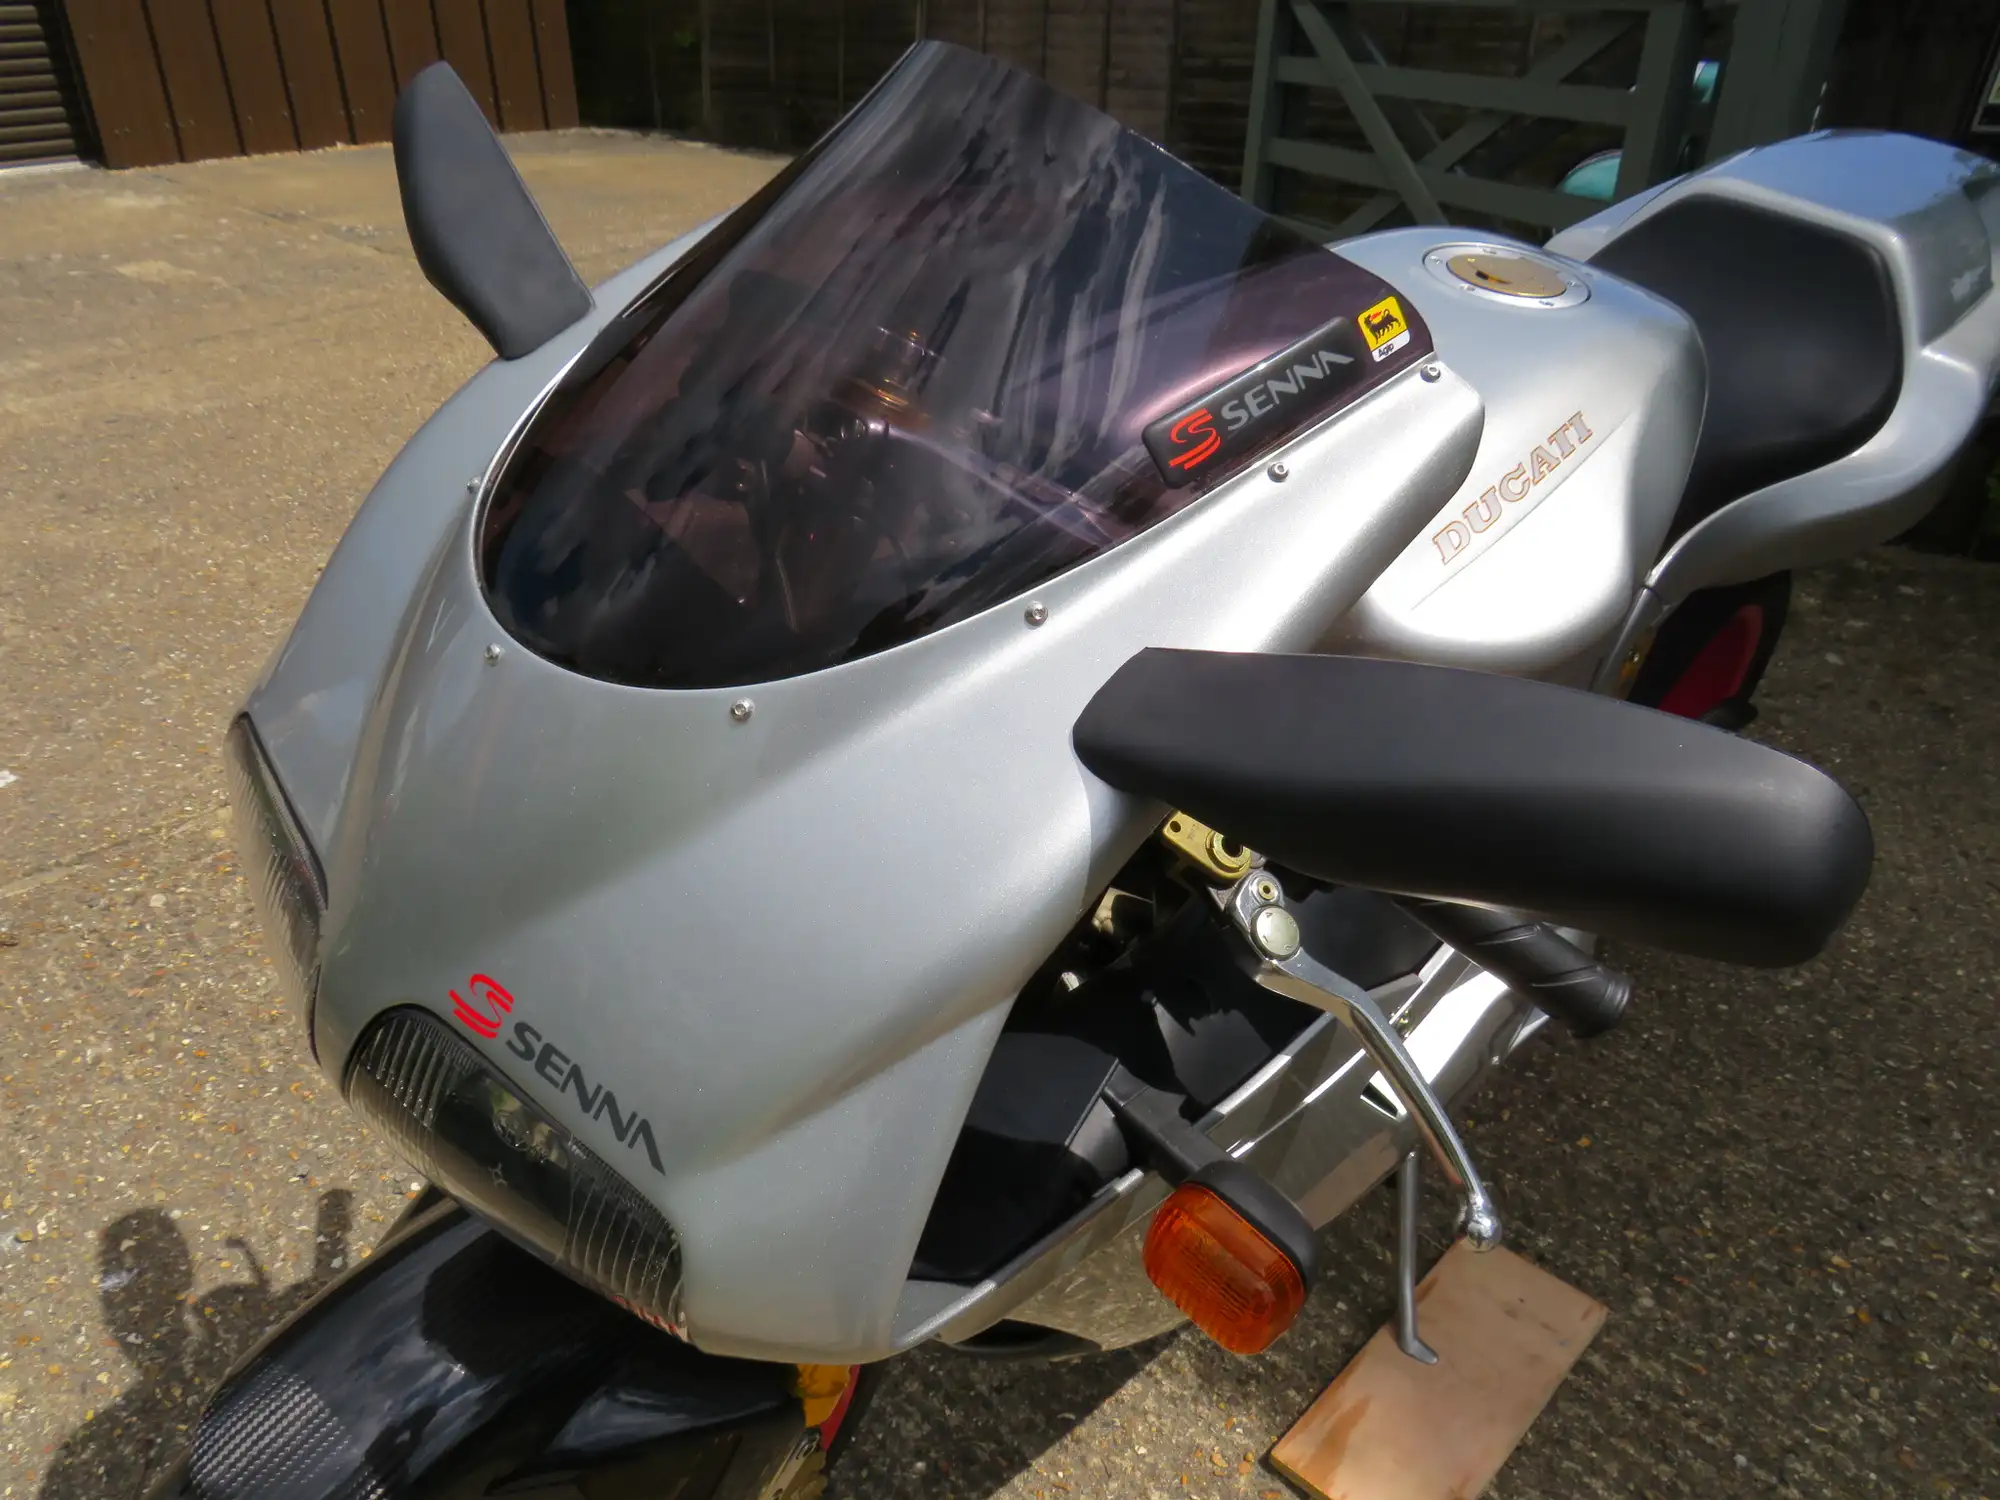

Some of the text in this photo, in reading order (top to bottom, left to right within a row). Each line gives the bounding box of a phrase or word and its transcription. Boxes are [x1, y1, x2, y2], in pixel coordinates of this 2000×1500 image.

[1220, 350, 1355, 432] SENNA
[1432, 410, 1593, 565] DUCATI
[505, 1021, 667, 1177] SENNA
